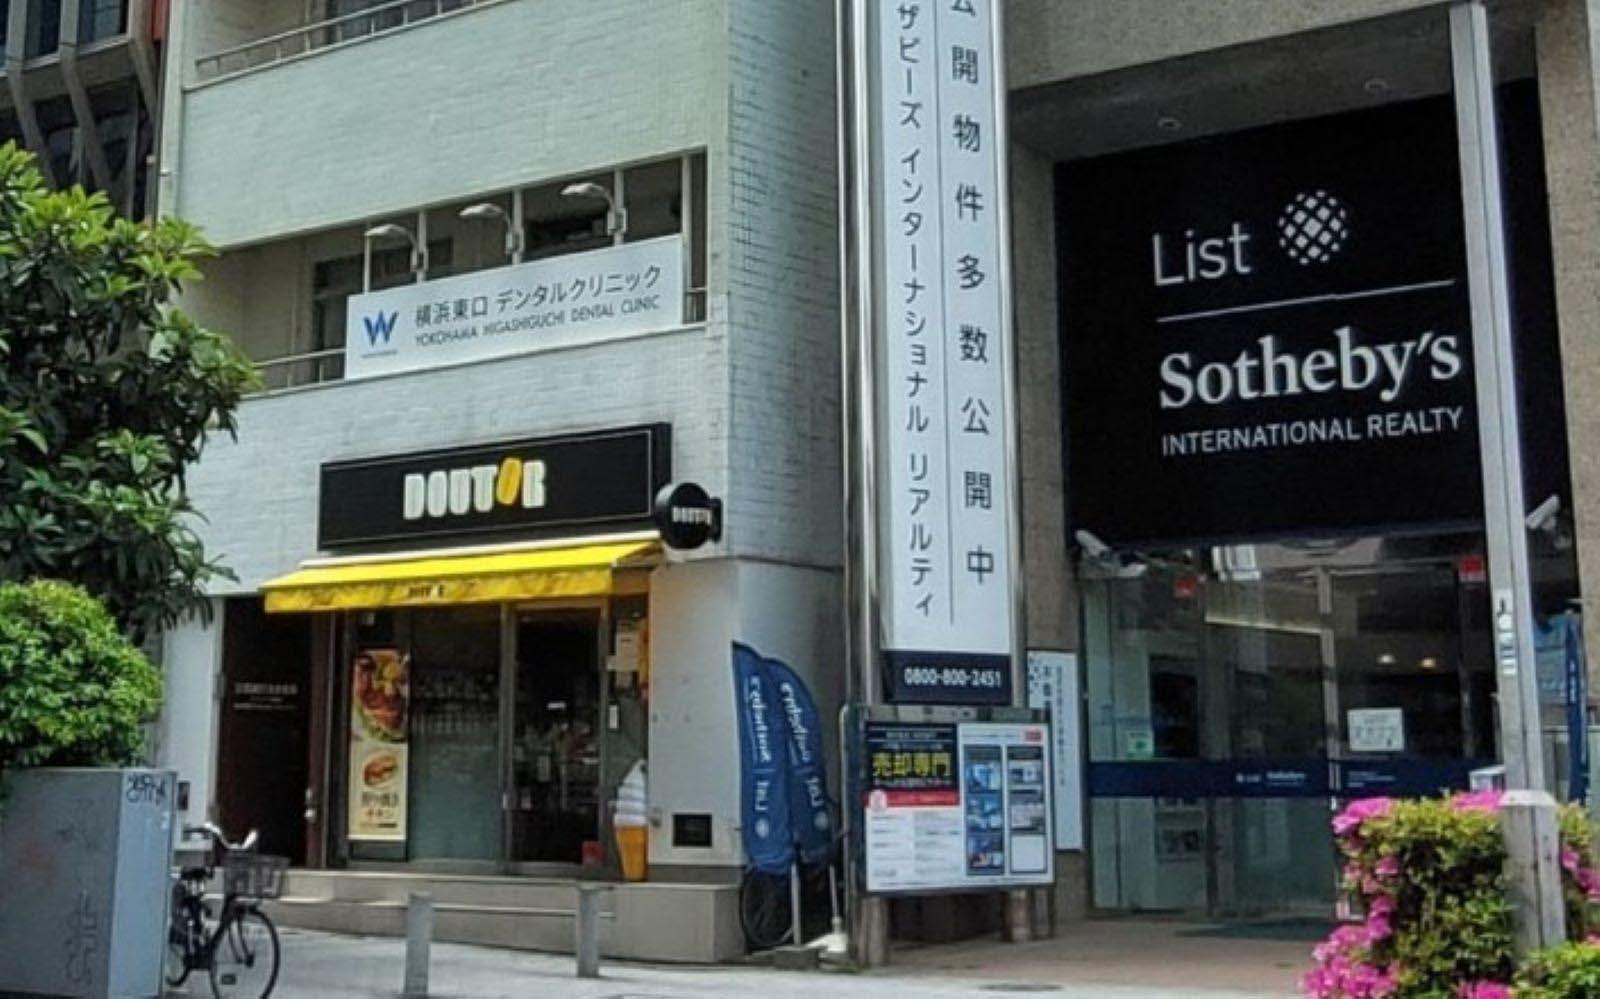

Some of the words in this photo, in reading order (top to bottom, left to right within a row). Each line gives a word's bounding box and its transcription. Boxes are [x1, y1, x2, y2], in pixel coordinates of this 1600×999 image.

[1153, 222, 1251, 286] List
[415, 295, 488, 328] 横浜東口
[496, 265, 660, 311] デンタルクリニック
[415, 326, 478, 346] YOKOHAMA
[571, 303, 615, 322] DENTAL
[621, 294, 660, 314] CLINIC
[901, 148, 930, 432] インターナショナル
[1159, 325, 1461, 410] Sotheby's
[1162, 418, 1362, 457] INTERNATIONAL
[1367, 406, 1464, 439] REALTY
[403, 457, 546, 520] DOUTOR
[908, 453, 933, 617] リアルティ
